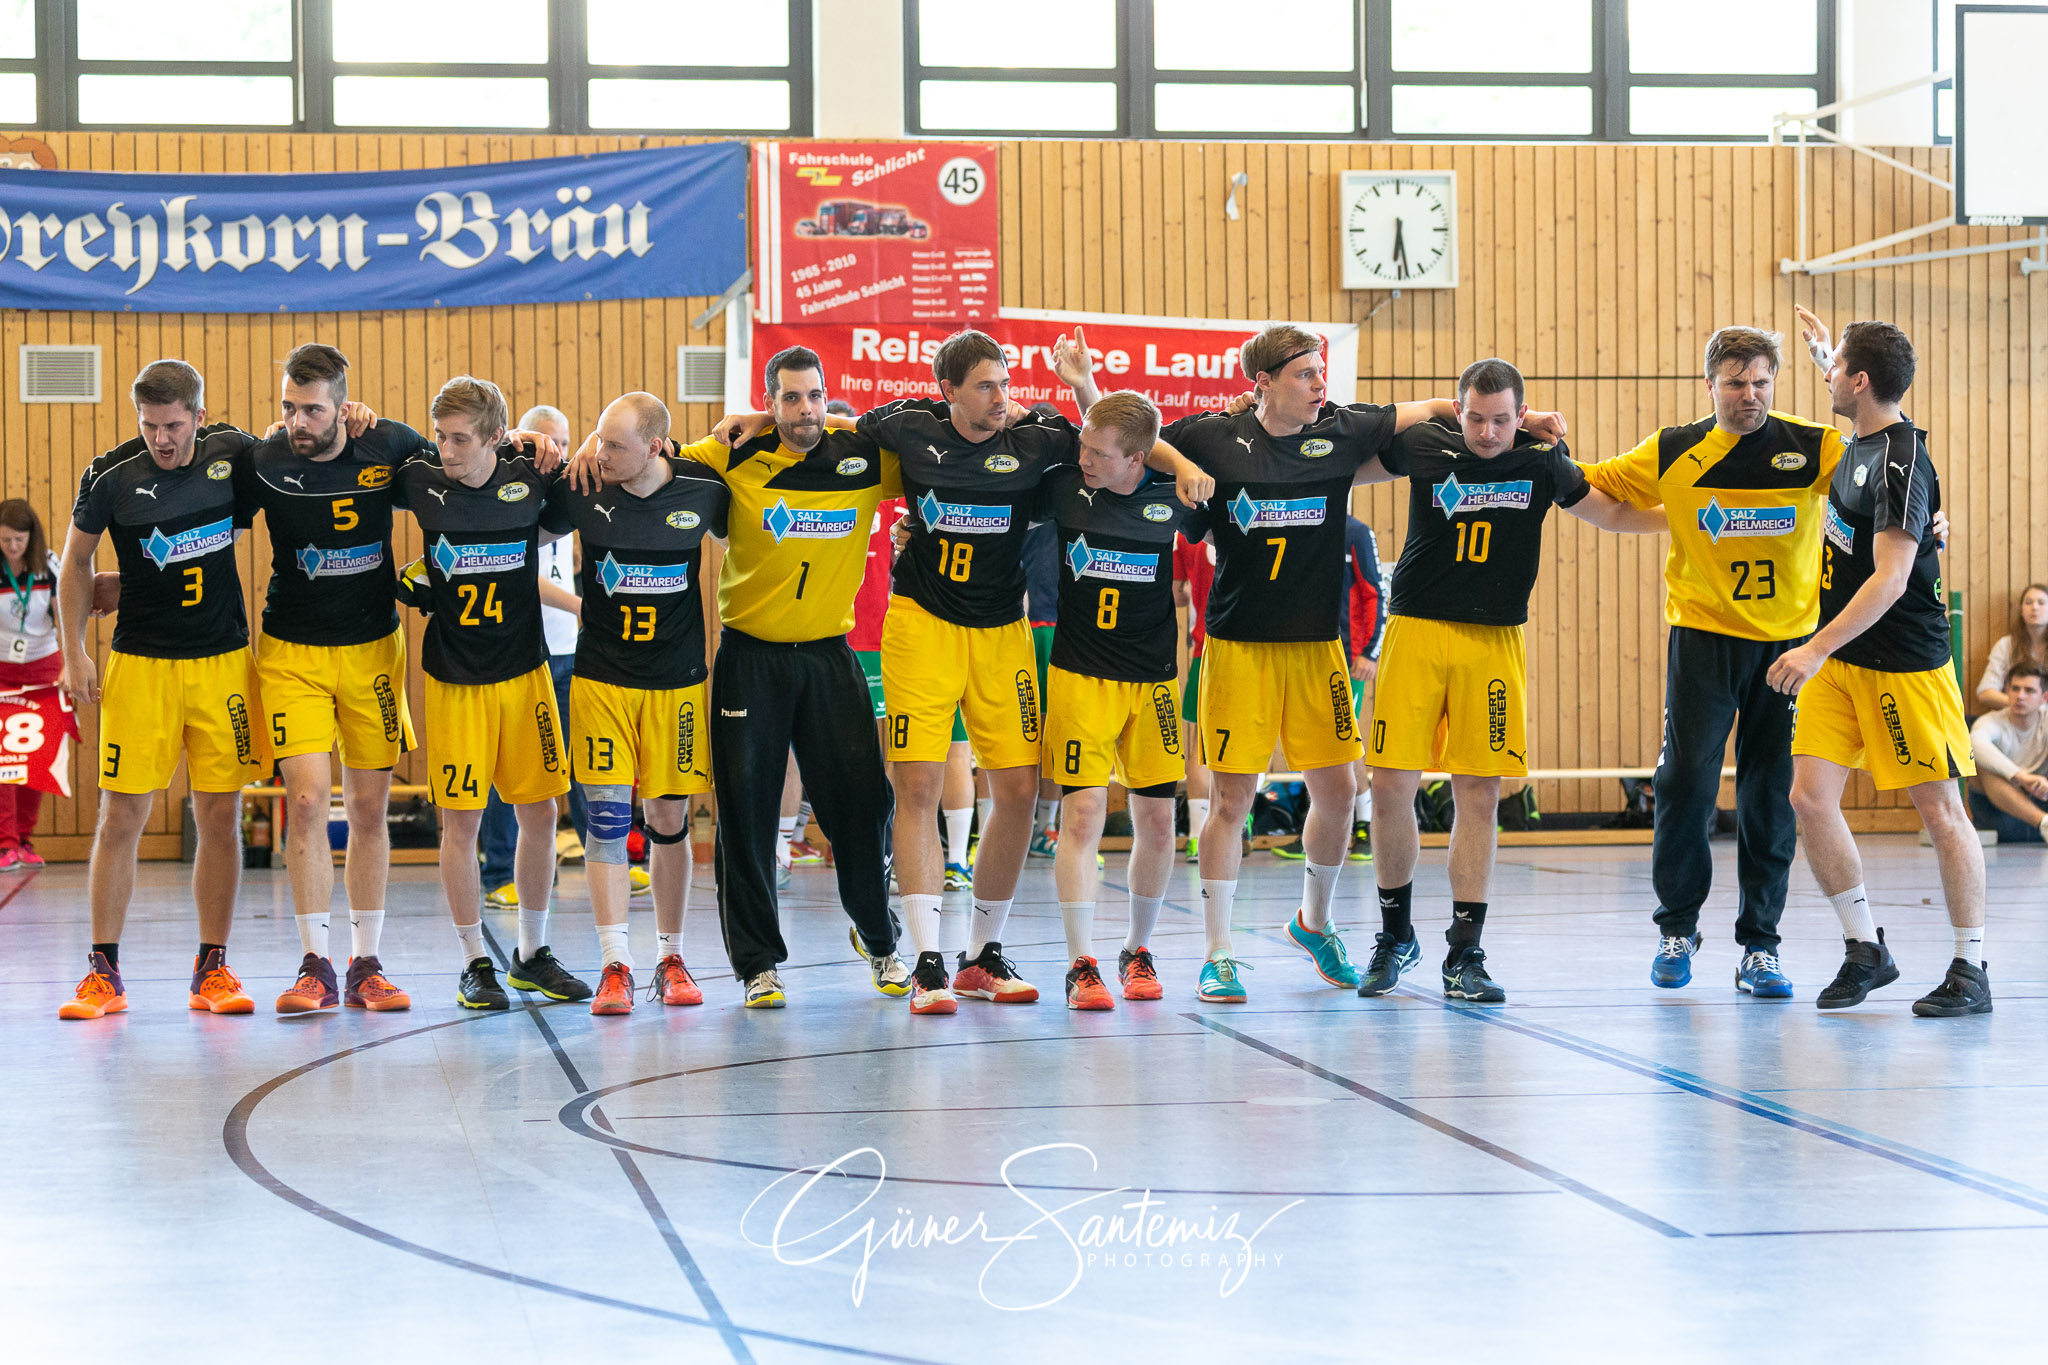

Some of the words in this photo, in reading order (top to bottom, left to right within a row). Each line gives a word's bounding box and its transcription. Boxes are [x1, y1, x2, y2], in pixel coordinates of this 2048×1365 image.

[789, 152, 874, 166] Fahrschule
[851, 148, 925, 187] Schlicht
[944, 167, 978, 194] 45
[791, 264, 821, 283] 1965
[826, 253, 857, 272] 2010
[796, 284, 812, 299] 45
[812, 278, 843, 295] Jahre
[800, 290, 860, 316] Fahrschule
[860, 275, 906, 298] Schlicht
[1145, 344, 1240, 379] Lauf
[841, 373, 873, 392] Ihre
[877, 376, 942, 397] regiona
[1154, 389, 1191, 407] Lauf
[1260, 502, 1286, 511] SALZ
[1468, 485, 1495, 495] SALZ
[1468, 491, 1527, 505] HELMREICH
[331, 497, 359, 531] 5
[796, 521, 854, 532] HELMREICH
[797, 512, 823, 522] SALZ
[945, 515, 1007, 527] HELMREICH
[946, 506, 972, 516] SALZ
[1260, 509, 1323, 520] HELMREICH
[1730, 510, 1756, 520] SALZ
[1730, 518, 1793, 530] HELMREICH
[175, 529, 201, 545] SALZ
[176, 530, 231, 554] HELMREICH
[327, 550, 351, 559] SALZ
[461, 547, 487, 556] SALZ
[1456, 521, 1492, 563] 10
[327, 552, 379, 569] HELMREICH
[462, 552, 523, 567] HELMREICH
[551, 565, 562, 580] A
[627, 567, 653, 577] SALZ
[938, 538, 974, 582] 18
[1094, 561, 1154, 574] HELMREICH
[1095, 551, 1122, 562] SALZ
[1266, 537, 1287, 581] 7
[181, 566, 203, 607] 3
[626, 574, 685, 587] HELMREICH
[796, 561, 810, 600] 1
[1730, 559, 1776, 601] 23
[458, 582, 503, 626] 24
[1096, 588, 1120, 630] 8
[620, 605, 656, 641] 13
[13, 639, 25, 653] C
[374, 685, 391, 738] ROBERT
[384, 680, 399, 738] MEIER
[1016, 681, 1031, 735] ROBERT
[1024, 678, 1039, 735] MEIER
[1153, 696, 1171, 748] ROBERT
[1161, 692, 1179, 748] MEIER
[1329, 684, 1344, 733] ROBERT
[1337, 680, 1353, 733] MEIER
[1488, 689, 1497, 744] ROBERT
[1497, 686, 1507, 744] MEIER
[0, 712, 44, 753] 8
[227, 707, 244, 759] ROBERT
[235, 702, 250, 760] MEIER
[272, 713, 286, 746] 5
[536, 714, 552, 767] ROBERT
[542, 710, 559, 767] MEIER
[678, 714, 686, 767] ROBERT
[685, 710, 694, 767] MEIER
[1216, 729, 1230, 762] 7
[1889, 702, 1911, 757] MEIER
[103, 742, 121, 778] 3
[586, 736, 614, 771] 13
[1065, 739, 1081, 775] 8
[443, 763, 478, 798] 24
